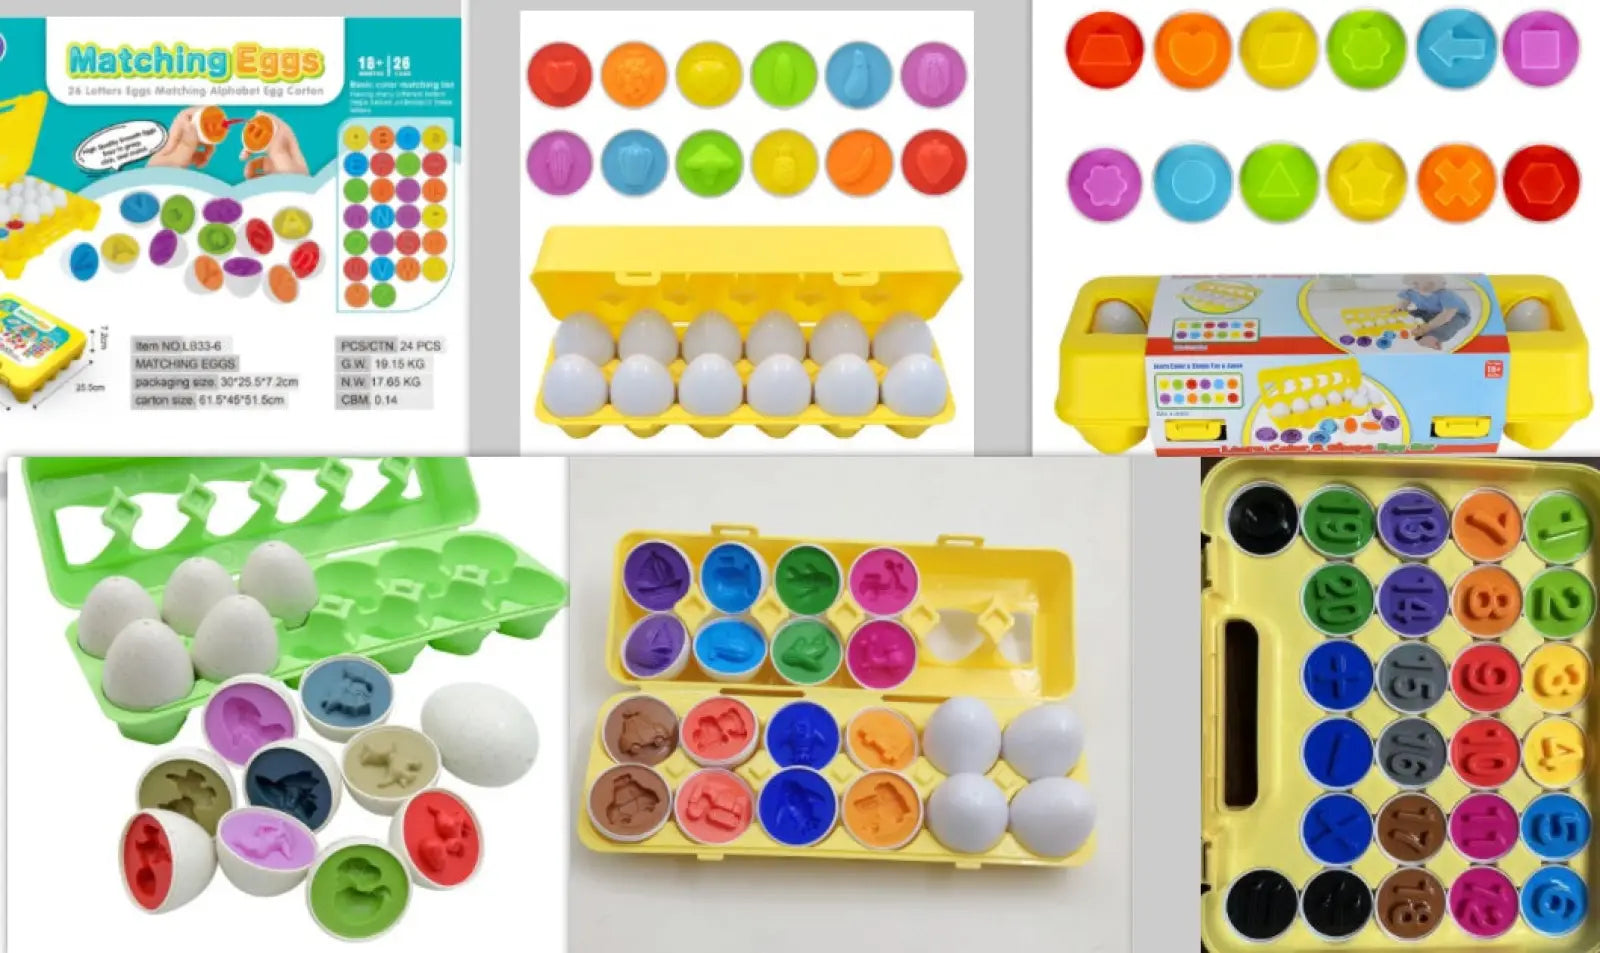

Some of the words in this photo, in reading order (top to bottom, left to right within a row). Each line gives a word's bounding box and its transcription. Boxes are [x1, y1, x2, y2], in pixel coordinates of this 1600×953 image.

[68, 44, 229, 81] Matching
[235, 44, 322, 81] Eggs
[85, 86, 121, 96] Letters
[126, 86, 151, 98] Eggs
[155, 86, 206, 97] Matching
[210, 86, 259, 97] Alphabet
[263, 86, 284, 97] Egg
[287, 86, 324, 96] Carton
[136, 358, 198, 369] MATCHING
[201, 358, 236, 369] EGGS
[400, 341, 413, 351] 24
[416, 341, 442, 352] PCS
[407, 359, 425, 369] KG
[135, 394, 169, 405] carton
[136, 377, 189, 389] packaging
[403, 376, 421, 387] KG
[1314, 575, 1359, 626] 20
[1391, 578, 1435, 624] 14
[1463, 586, 1511, 620] 8
[1533, 586, 1582, 622] 2
[1390, 655, 1435, 700] 15
[1534, 662, 1583, 698] 3
[1462, 728, 1511, 777] 10
[1539, 736, 1584, 772] 4
[1389, 805, 1436, 853] 17
[1461, 805, 1507, 849] 11
[1531, 811, 1578, 846] 5
